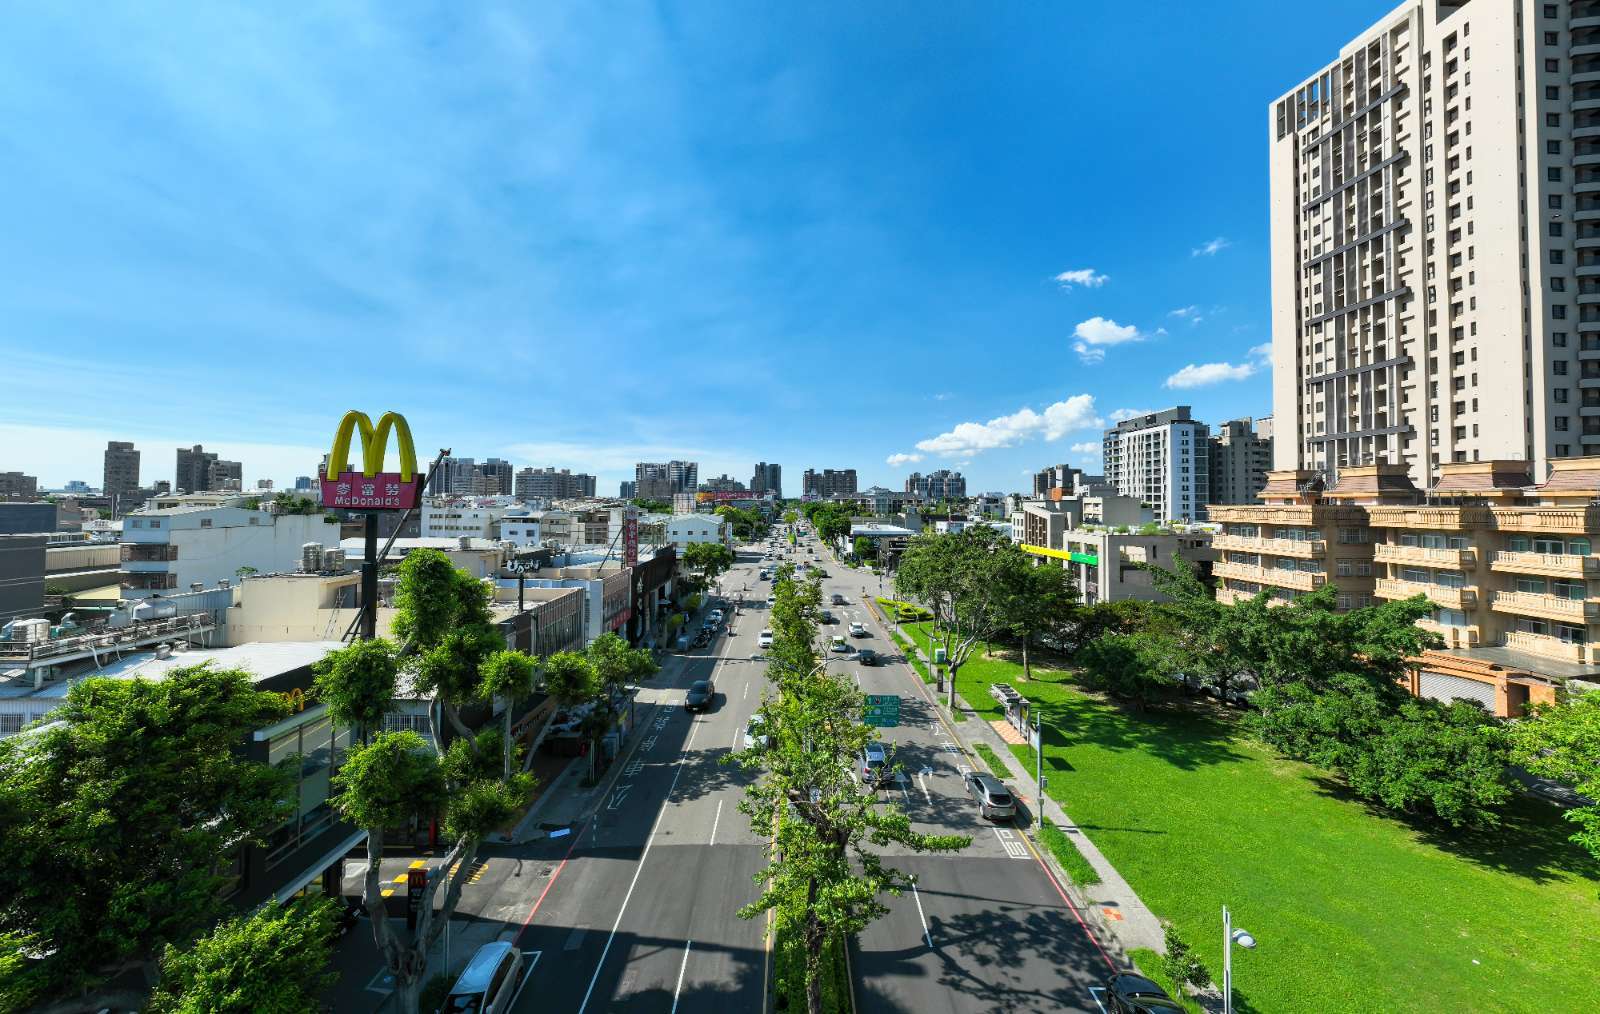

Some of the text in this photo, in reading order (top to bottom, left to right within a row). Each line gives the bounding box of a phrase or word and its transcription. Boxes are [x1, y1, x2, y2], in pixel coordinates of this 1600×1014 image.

[336, 483, 401, 496] 麥當勞
[334, 496, 400, 506] McDonald's
